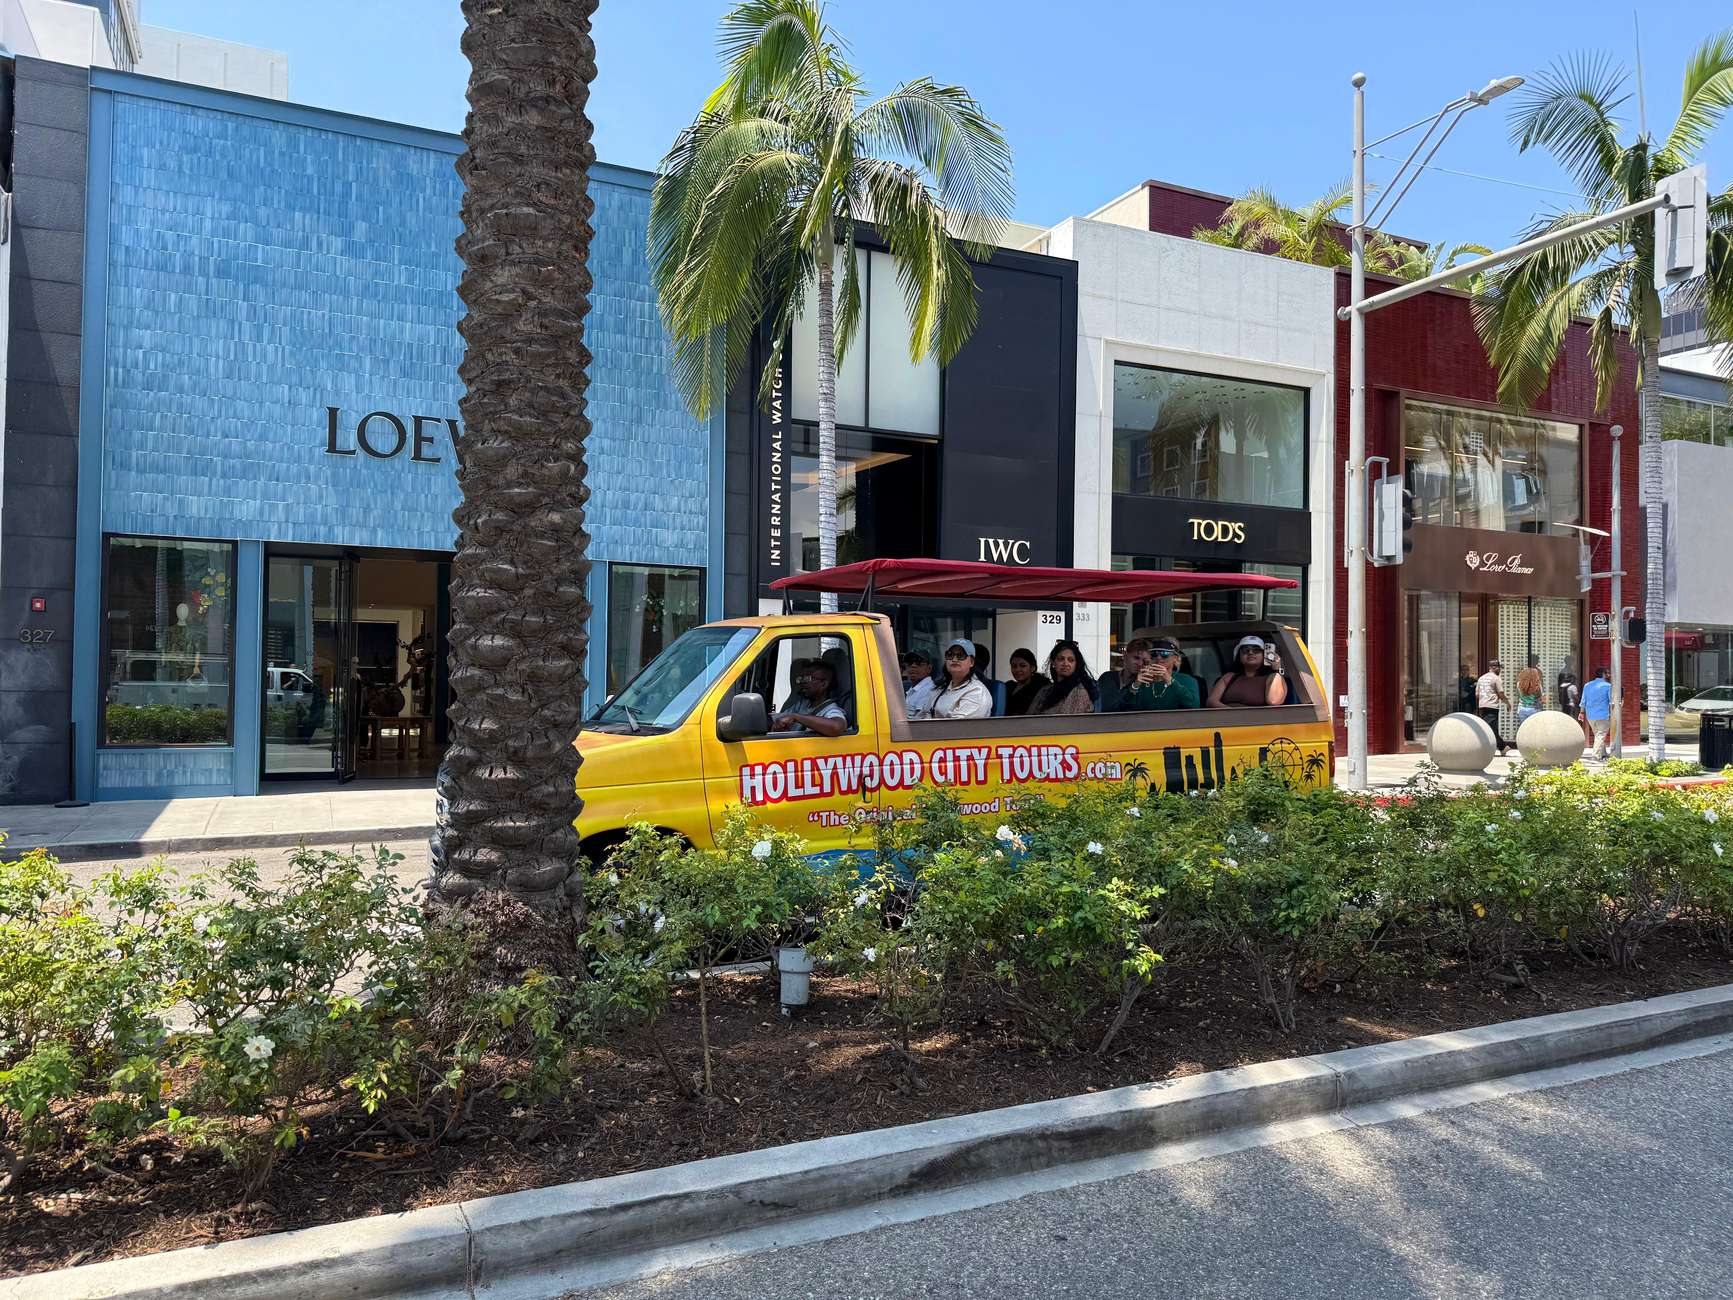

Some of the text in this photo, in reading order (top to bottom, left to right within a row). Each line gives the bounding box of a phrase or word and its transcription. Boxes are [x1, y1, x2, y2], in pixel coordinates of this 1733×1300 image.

[770, 431, 782, 567] INTERNATIONAL
[1187, 518, 1245, 544] TOD'S
[977, 537, 1031, 565] IWC
[1479, 552, 1535, 574] Loro Piana
[1041, 614, 1062, 625] 329
[1075, 612, 1090, 622] 333
[20, 628, 56, 643] 327
[741, 750, 923, 804] HOLLYWOOD
[931, 747, 990, 784] CITY
